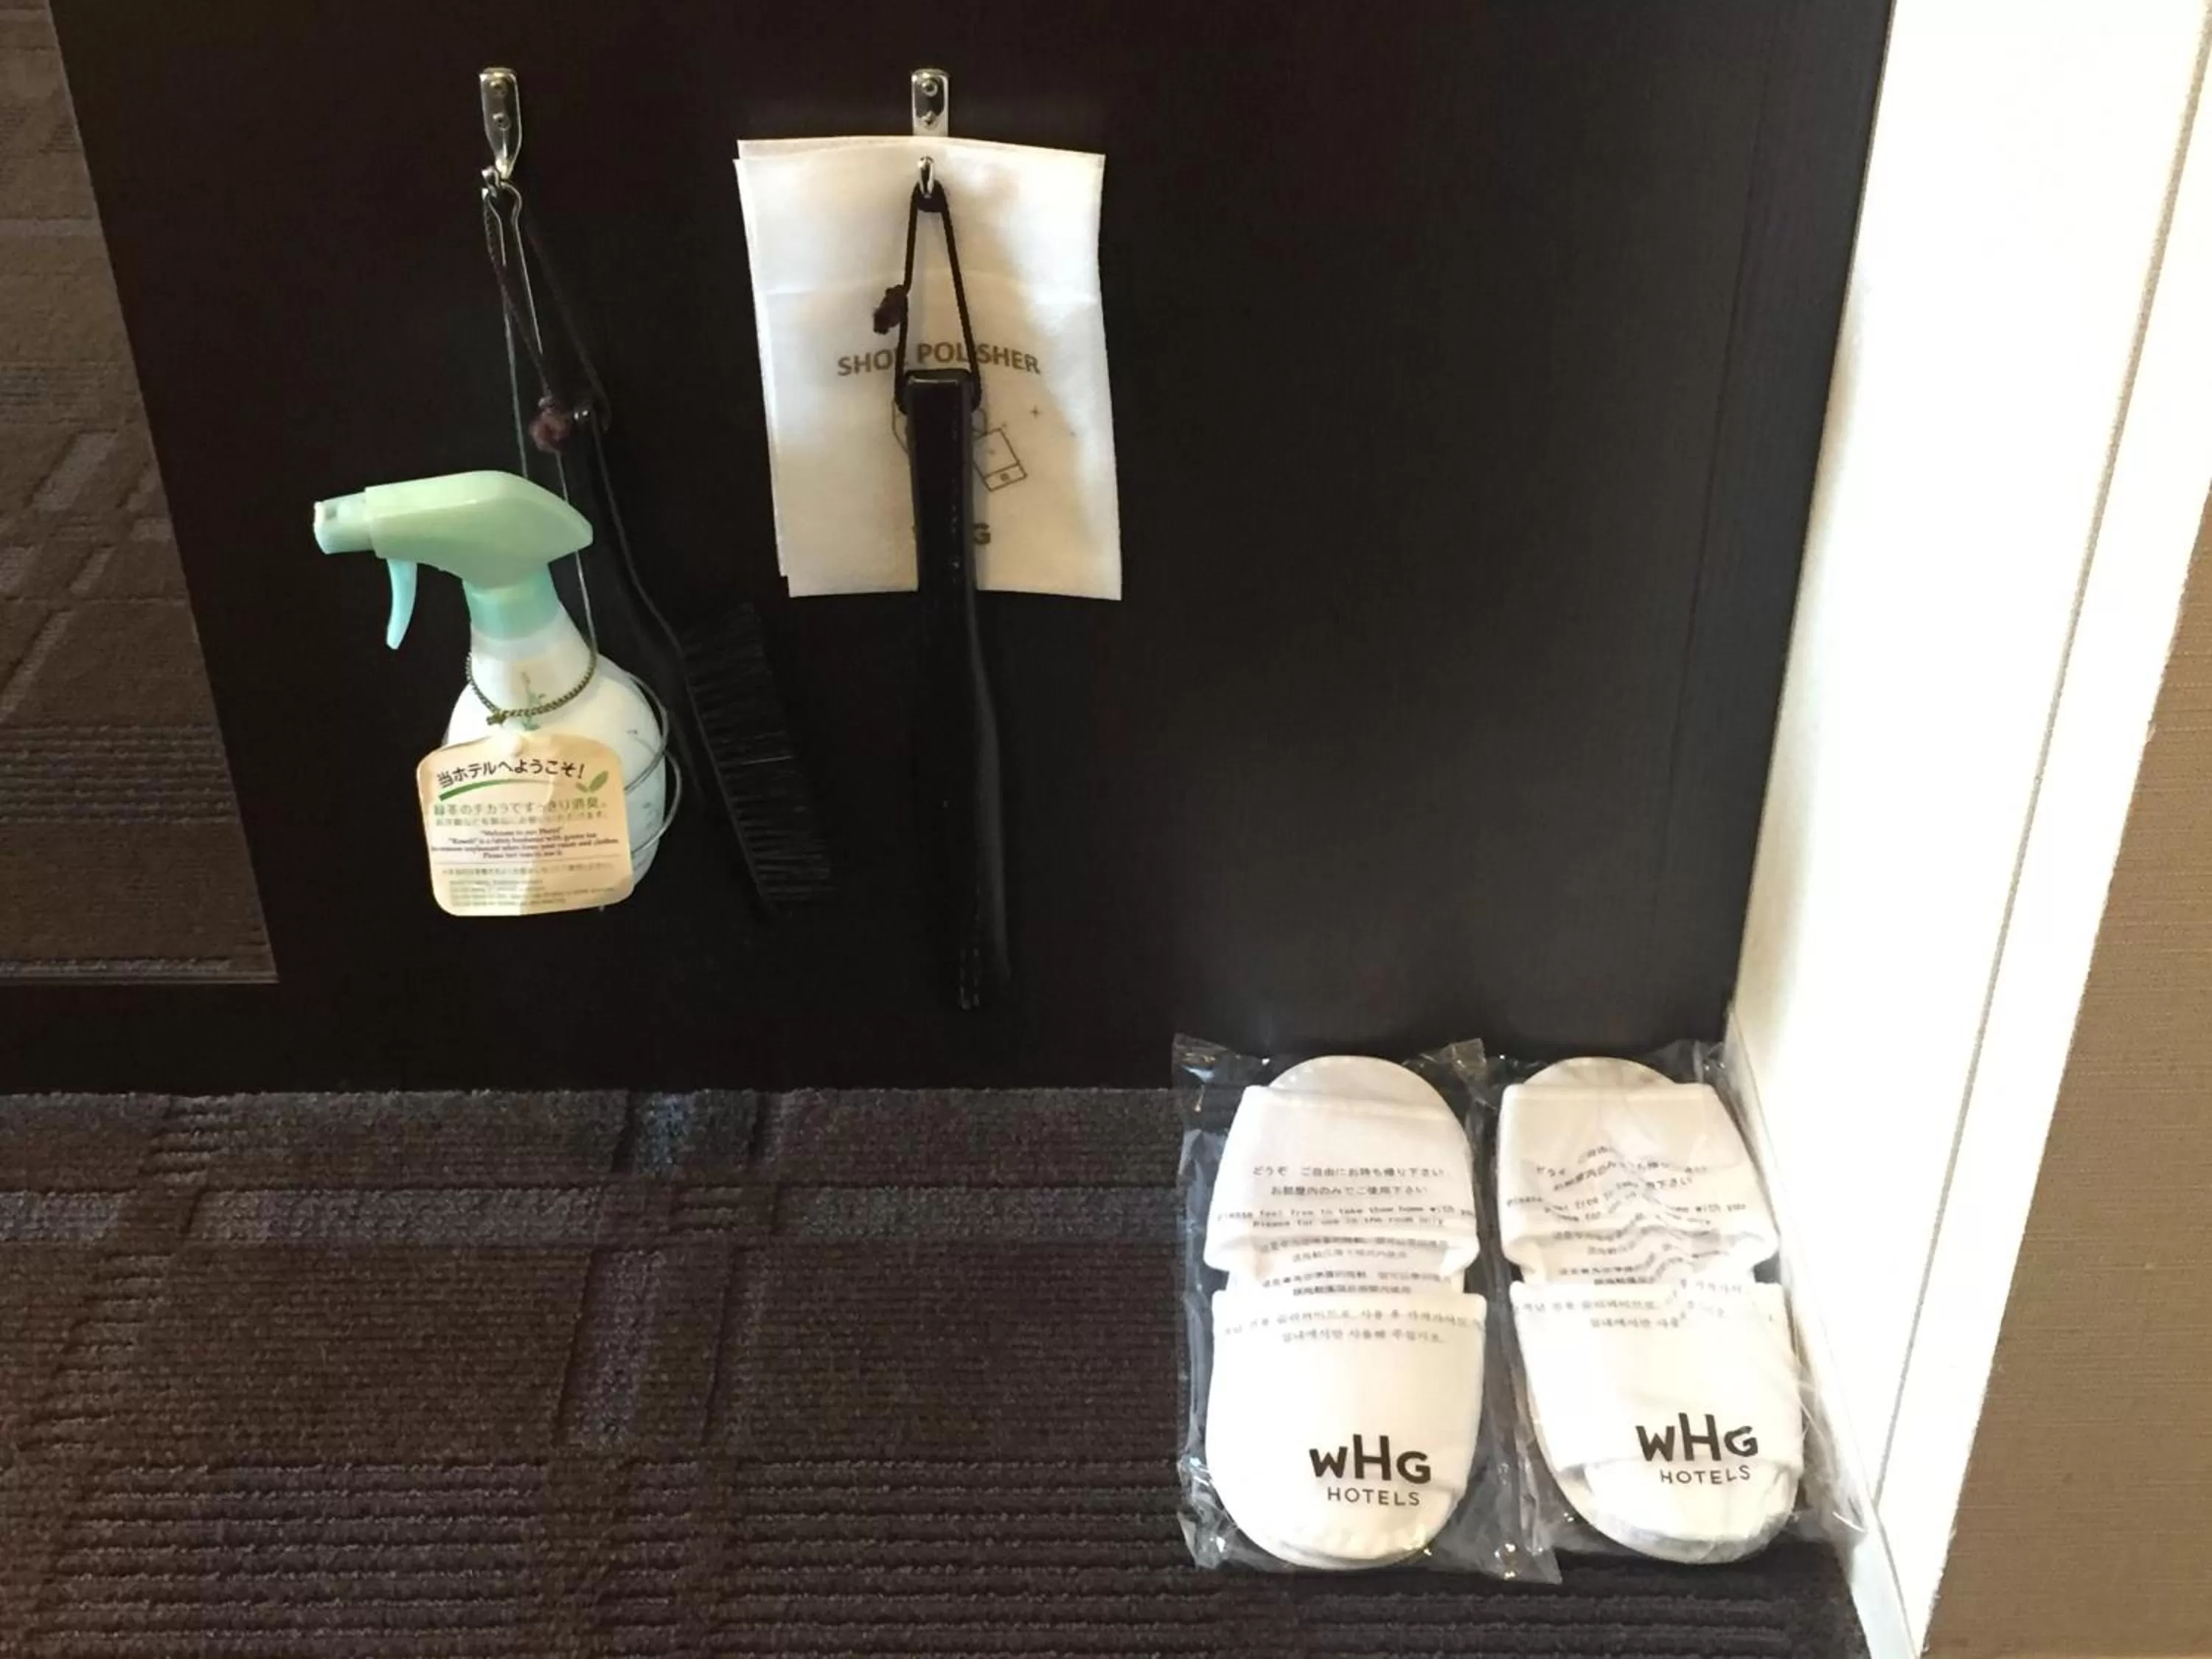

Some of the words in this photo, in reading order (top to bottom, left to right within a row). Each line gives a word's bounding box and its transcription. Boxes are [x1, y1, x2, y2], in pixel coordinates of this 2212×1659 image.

[917, 342, 1040, 374] POLSHER
[1660, 1464, 1750, 1485] HOTELS
[1328, 1486, 1420, 1506] HOTELS
